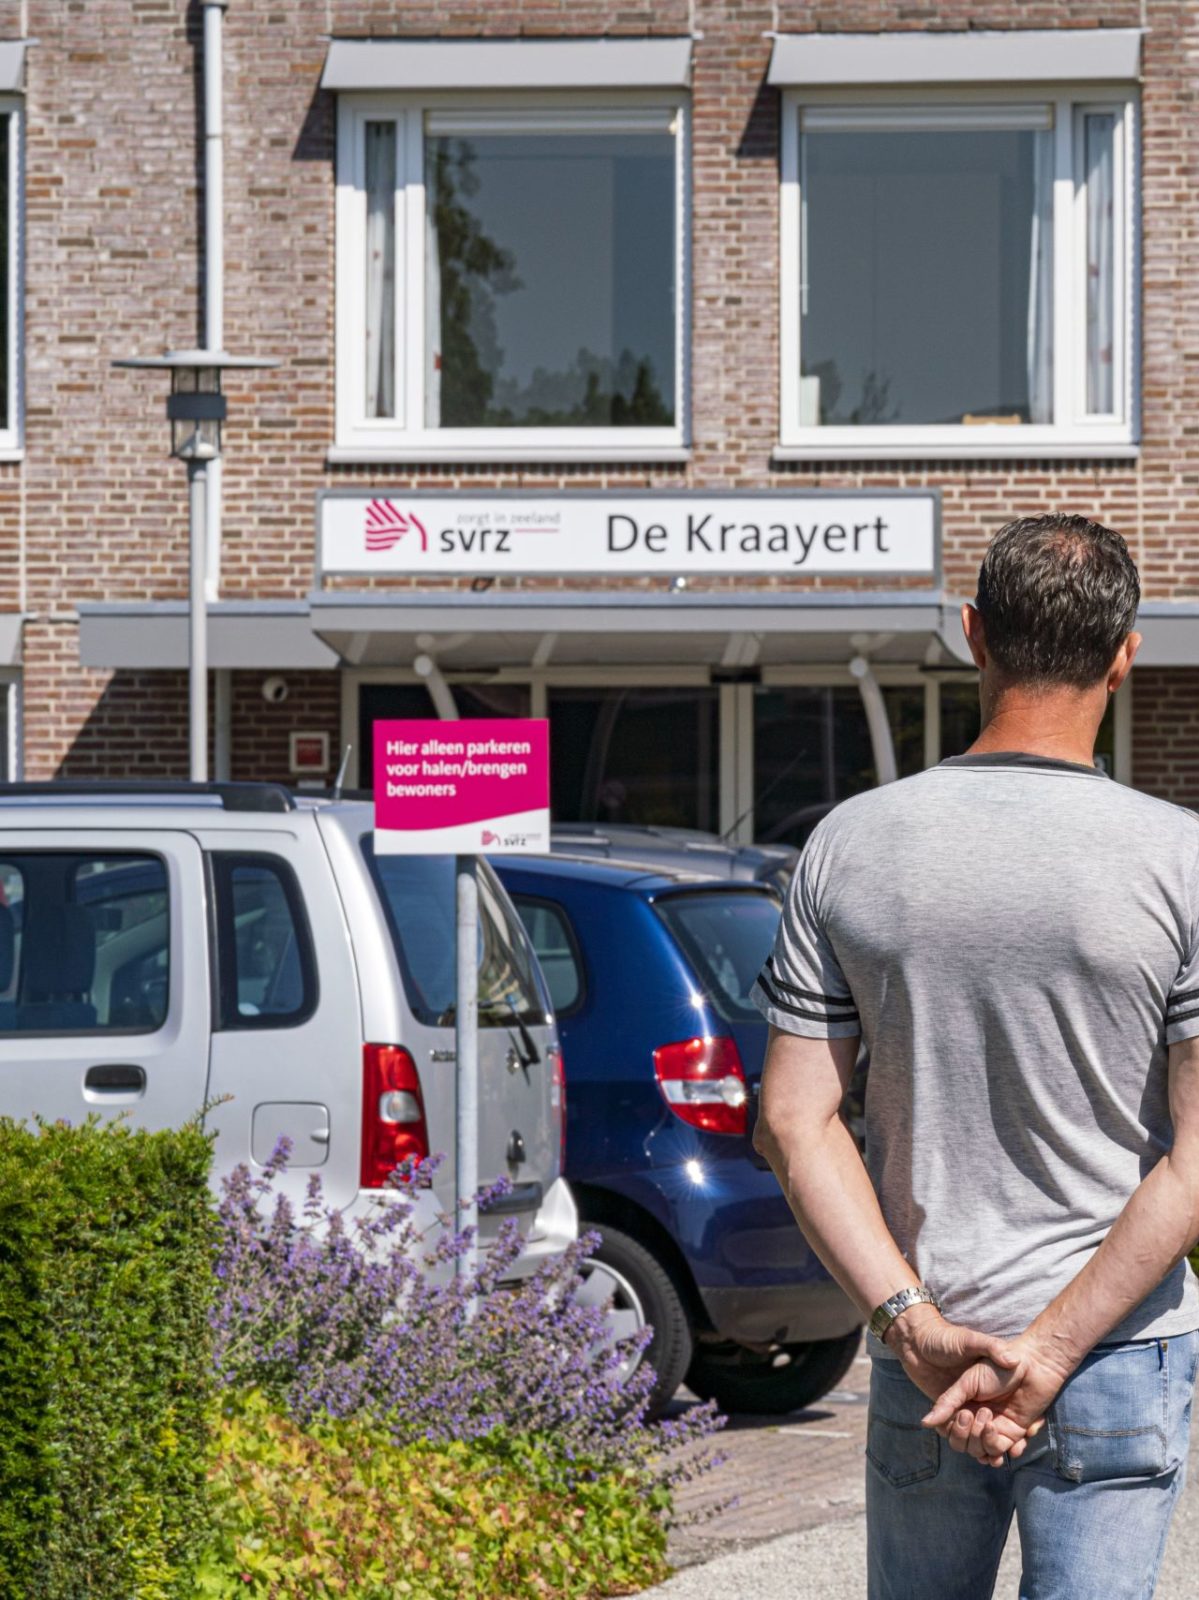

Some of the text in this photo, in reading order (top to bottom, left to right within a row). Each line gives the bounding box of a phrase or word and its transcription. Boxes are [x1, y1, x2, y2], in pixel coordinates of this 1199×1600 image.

[494, 512, 506, 523] in
[510, 511, 561, 524] zeeland
[440, 529, 511, 552] svrz
[608, 514, 890, 565] De Kraayert
[386, 738, 531, 758] Hier alleen parkeren
[386, 760, 527, 779] voor halen/brengen
[386, 781, 456, 797] bewoners
